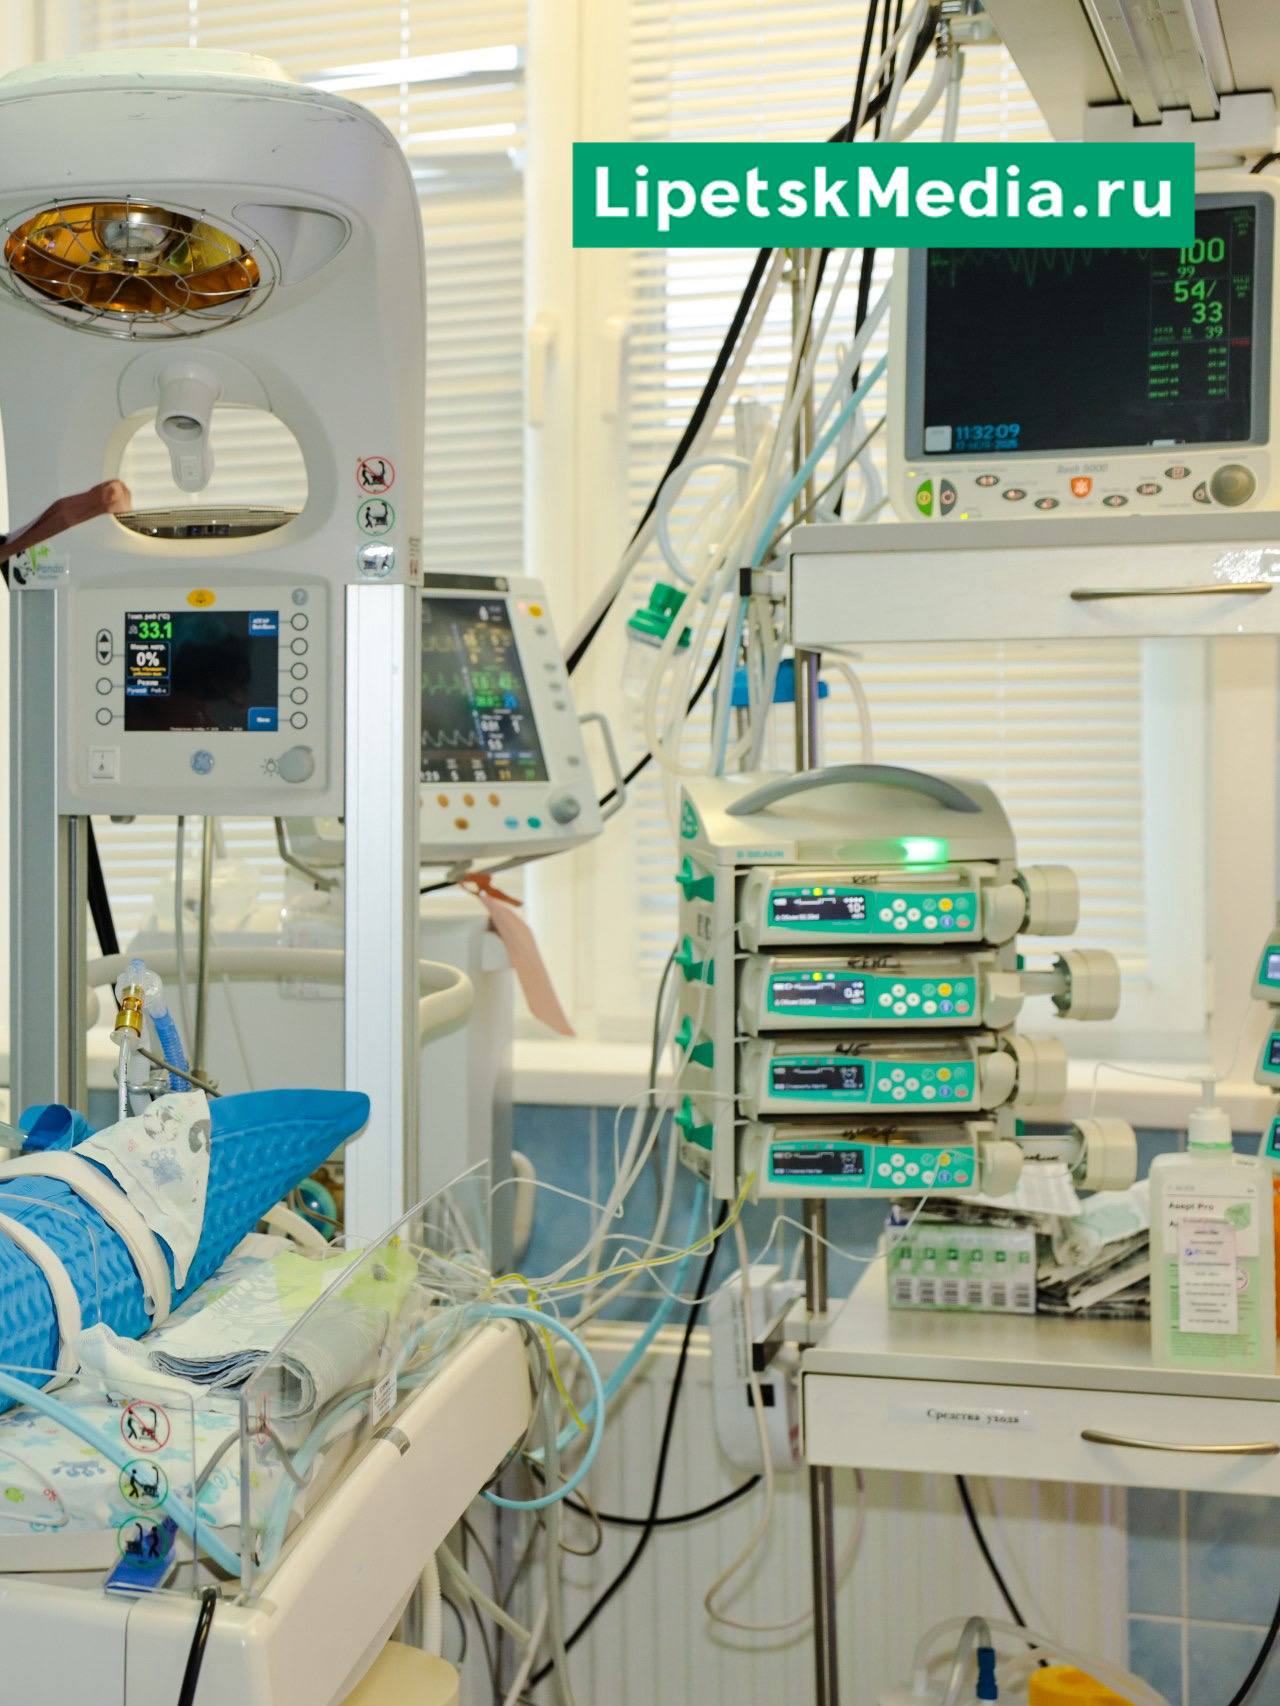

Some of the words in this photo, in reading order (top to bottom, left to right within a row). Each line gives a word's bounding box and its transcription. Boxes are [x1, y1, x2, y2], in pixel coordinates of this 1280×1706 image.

[1191, 301, 1223, 324] 33
[138, 621, 173, 640] 33.1
[135, 651, 161, 668] 0%
